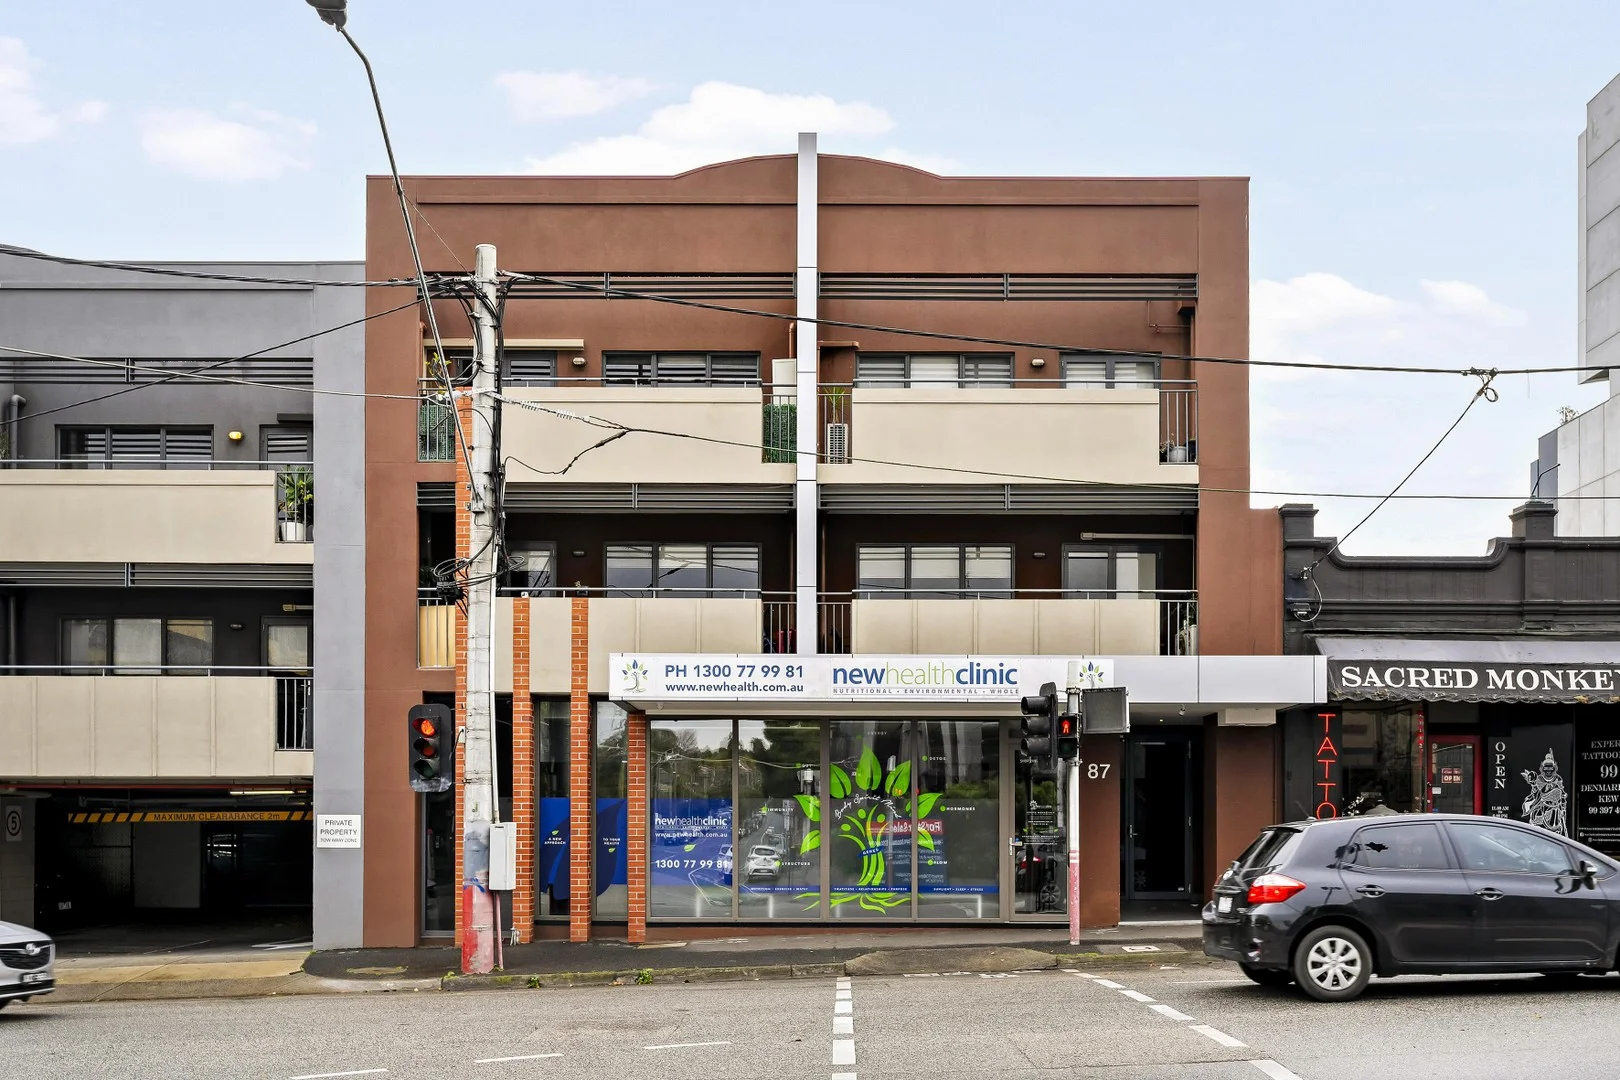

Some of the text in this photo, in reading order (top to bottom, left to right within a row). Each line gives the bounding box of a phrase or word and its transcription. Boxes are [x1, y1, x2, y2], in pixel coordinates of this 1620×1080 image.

[665, 665, 803, 678] PH 1300 77 99 81
[832, 662, 1018, 685] newhealthclinic
[1341, 666, 1479, 689] SACRED
[665, 682, 804, 693] www.newhealth.com.au
[1582, 751, 1620, 760] TATTOO
[1087, 763, 1111, 779] 87
[1495, 741, 1506, 789] OPEN
[1600, 764, 1618, 778] 99
[1598, 795, 1619, 803] KEW
[154, 811, 280, 821] MAXIMUM CLEARARANCE 2m
[11, 816, 17, 830] 5
[655, 859, 680, 869] 1300
[683, 859, 697, 868] 77
[699, 859, 713, 868] 99
